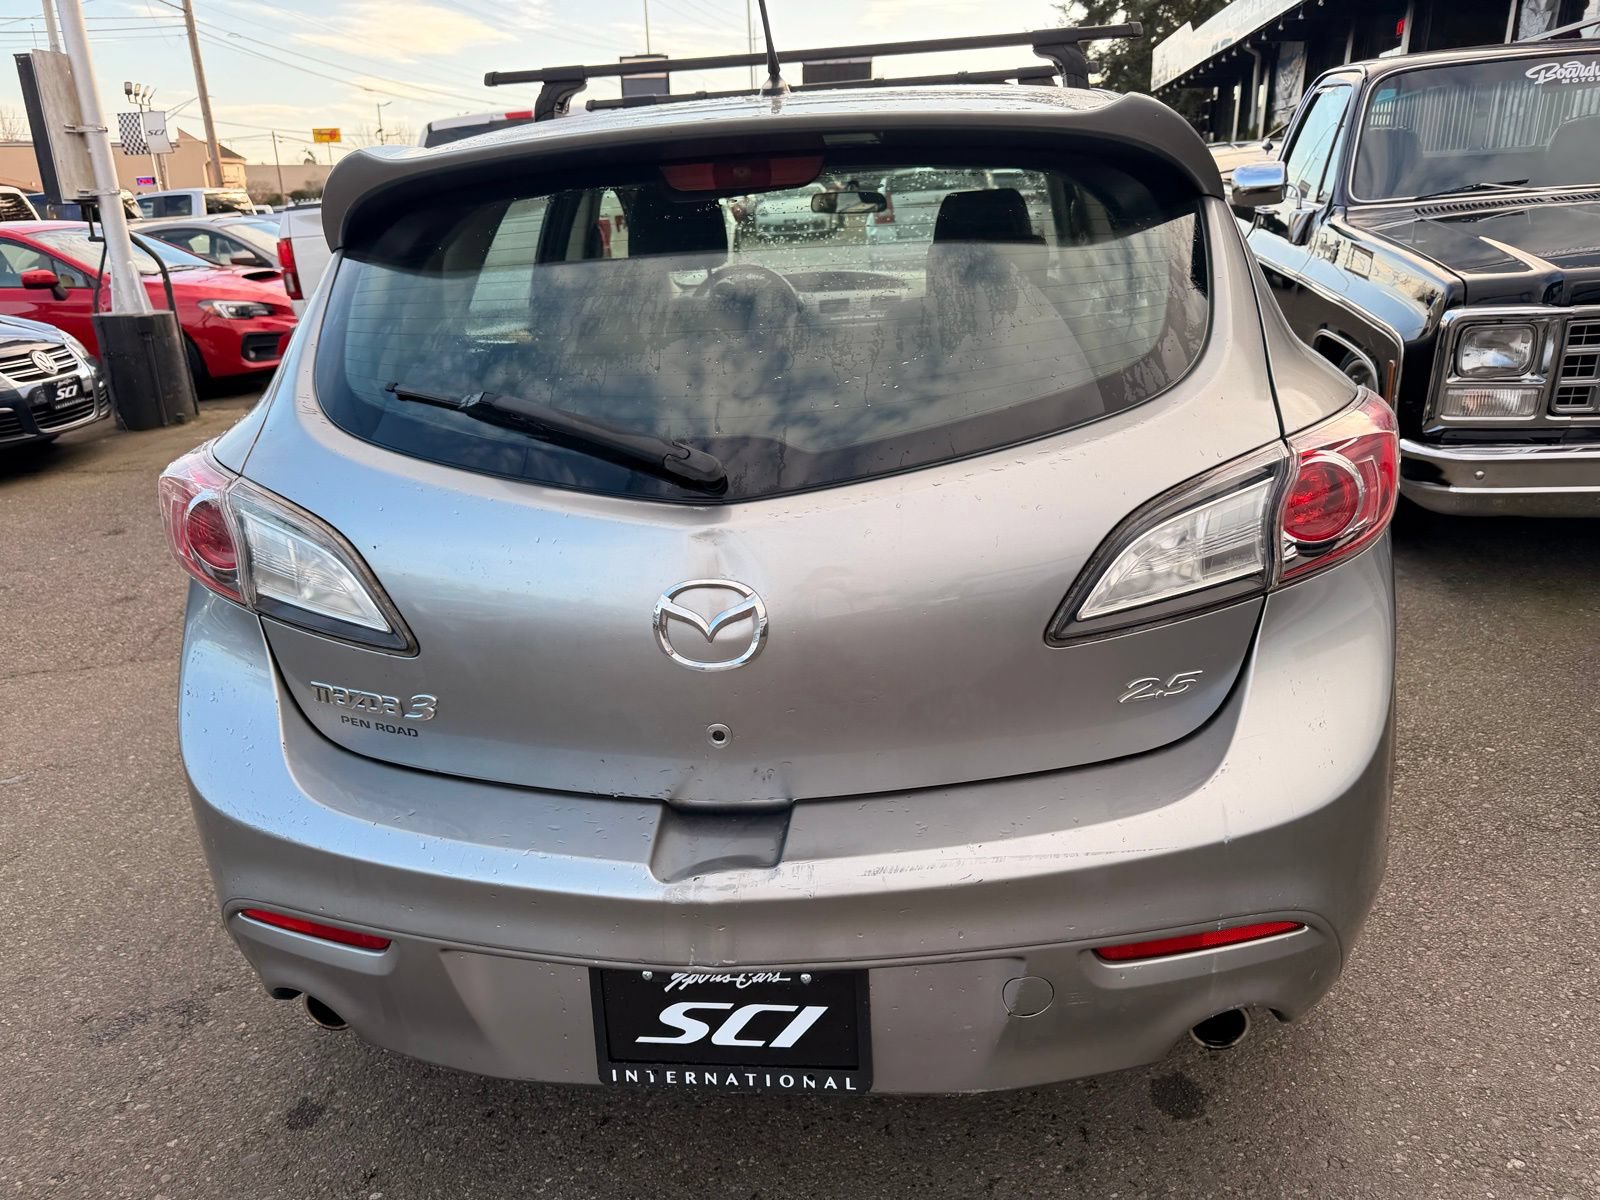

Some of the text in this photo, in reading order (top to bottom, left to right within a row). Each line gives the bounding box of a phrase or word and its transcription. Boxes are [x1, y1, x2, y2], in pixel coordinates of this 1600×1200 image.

[55, 385, 78, 401] SCI
[1118, 670, 1203, 703] 2.5
[404, 694, 438, 721] 3
[341, 715, 419, 738] PEN ROAD
[635, 1001, 828, 1048] SCI
[611, 1068, 857, 1091] INTERNATIONAL
